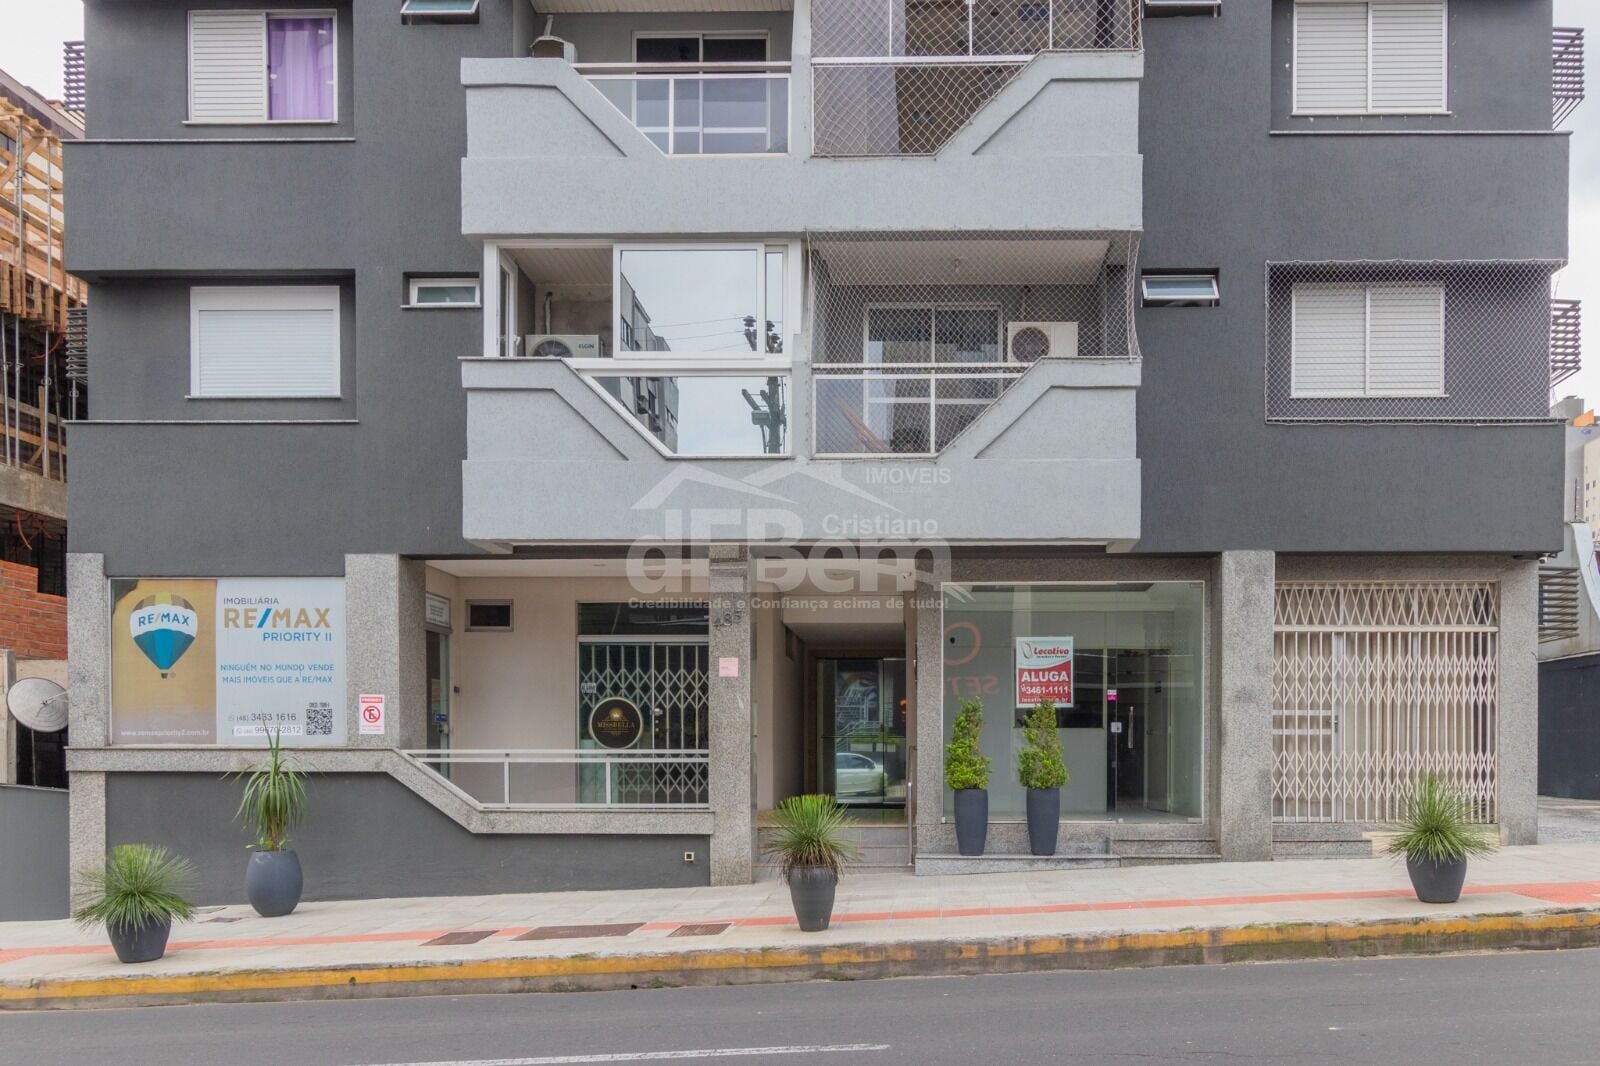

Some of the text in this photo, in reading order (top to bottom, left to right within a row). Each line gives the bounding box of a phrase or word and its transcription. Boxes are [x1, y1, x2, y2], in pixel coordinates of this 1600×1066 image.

[138, 612, 190, 627] RE/MAX
[223, 607, 331, 629] RE/MAX
[263, 632, 320, 641] PRIORITY
[220, 663, 257, 671] NINGUÉM
[222, 676, 241, 684] MAIS
[244, 675, 274, 684] IMÓVEIS
[276, 676, 292, 684] QUE
[302, 676, 333, 684] RE/MAX
[1021, 671, 1069, 682] ALUGA
[276, 713, 296, 721] 1616
